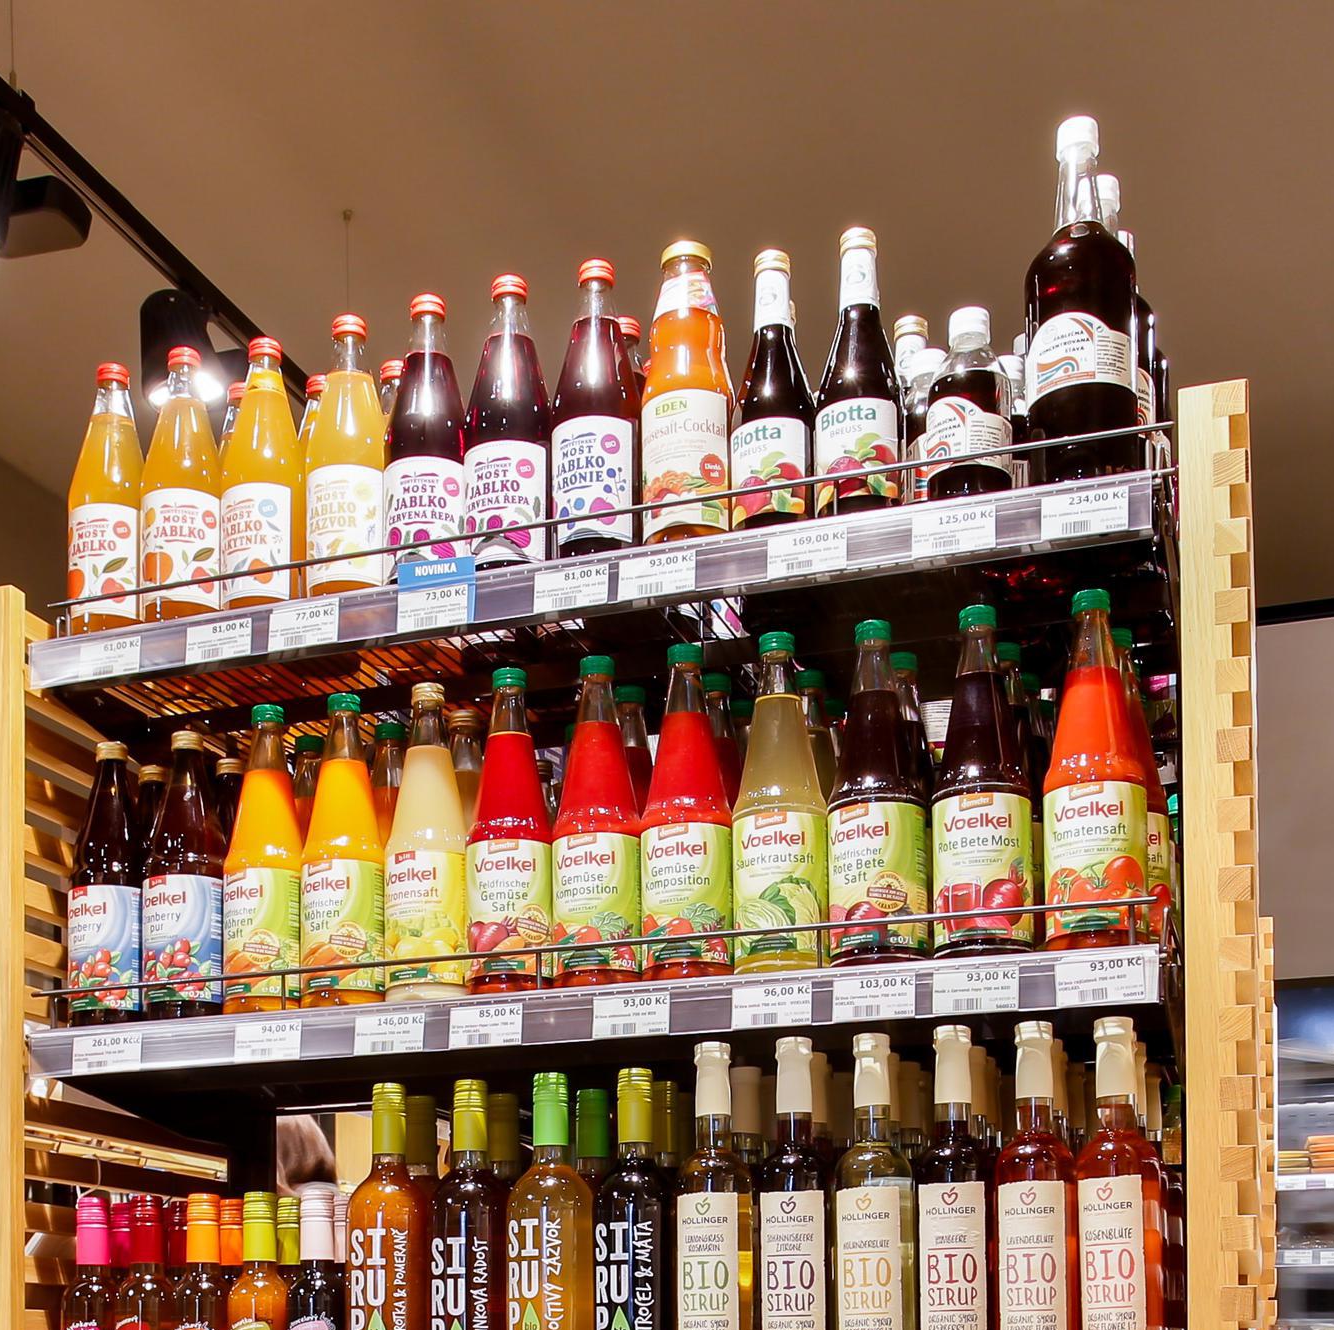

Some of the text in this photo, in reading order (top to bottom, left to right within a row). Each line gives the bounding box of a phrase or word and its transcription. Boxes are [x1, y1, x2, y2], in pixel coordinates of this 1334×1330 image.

[655, 400, 688, 416] EDEN
[820, 404, 877, 432] Biotta
[732, 425, 781, 452] Biotta
[829, 424, 863, 439] BREUSS
[557, 456, 605, 478] JABLKO
[394, 495, 447, 511] JABLKO
[1068, 490, 1127, 506] 234,00 Kč
[430, 506, 455, 523] ŘEPA
[153, 525, 205, 540] JABLKO
[792, 531, 845, 546] 169,00 Kč
[71, 539, 117, 556] JABLKO
[649, 553, 694, 568] 93,00 Kč
[414, 562, 457, 578] NOVINKA
[425, 586, 466, 601] 73,00 Kč
[296, 606, 335, 621] 77,00 Kč
[212, 620, 250, 635] 81,00 Kč
[1054, 801, 1124, 824] Voelkel
[944, 813, 1012, 834] Voelkel
[741, 831, 805, 850] Voelkel
[830, 820, 889, 845] Voelkel
[1052, 823, 1127, 842] Tomatensaft
[646, 840, 707, 862] Voelkel
[938, 835, 1020, 854] Rote Bete Most
[735, 851, 815, 871] Sauerkrautsaft
[833, 846, 883, 863] Feldfrischer
[474, 856, 536, 873] Voelkel
[651, 862, 700, 877] Gemüse-
[833, 857, 885, 876] Rote Bete
[478, 879, 530, 890] Feldfrischer
[645, 874, 710, 894] Komposition
[844, 871, 868, 886] Saft
[480, 889, 528, 901] Gemüse
[305, 908, 340, 921] Möhren
[491, 900, 516, 912] Saft
[309, 919, 330, 932] Saft
[763, 985, 810, 998] 96,00 Kč
[859, 977, 914, 990] 103,00 Kč
[377, 1014, 424, 1027] 146,00 Kč
[478, 1006, 521, 1019] 85,00 Kč
[633, 1220, 653, 1263] MÁTA
[684, 1233, 724, 1242] LEMONGRASS
[542, 1217, 562, 1276] ZÁZVOR
[390, 1227, 408, 1285] POMERANČ
[473, 1236, 489, 1284] RADOST
[1086, 1248, 1136, 1281] BIO
[682, 1260, 730, 1290] BIO
[683, 1293, 730, 1312] SIRUP
[1086, 1284, 1136, 1304] SIRUP
